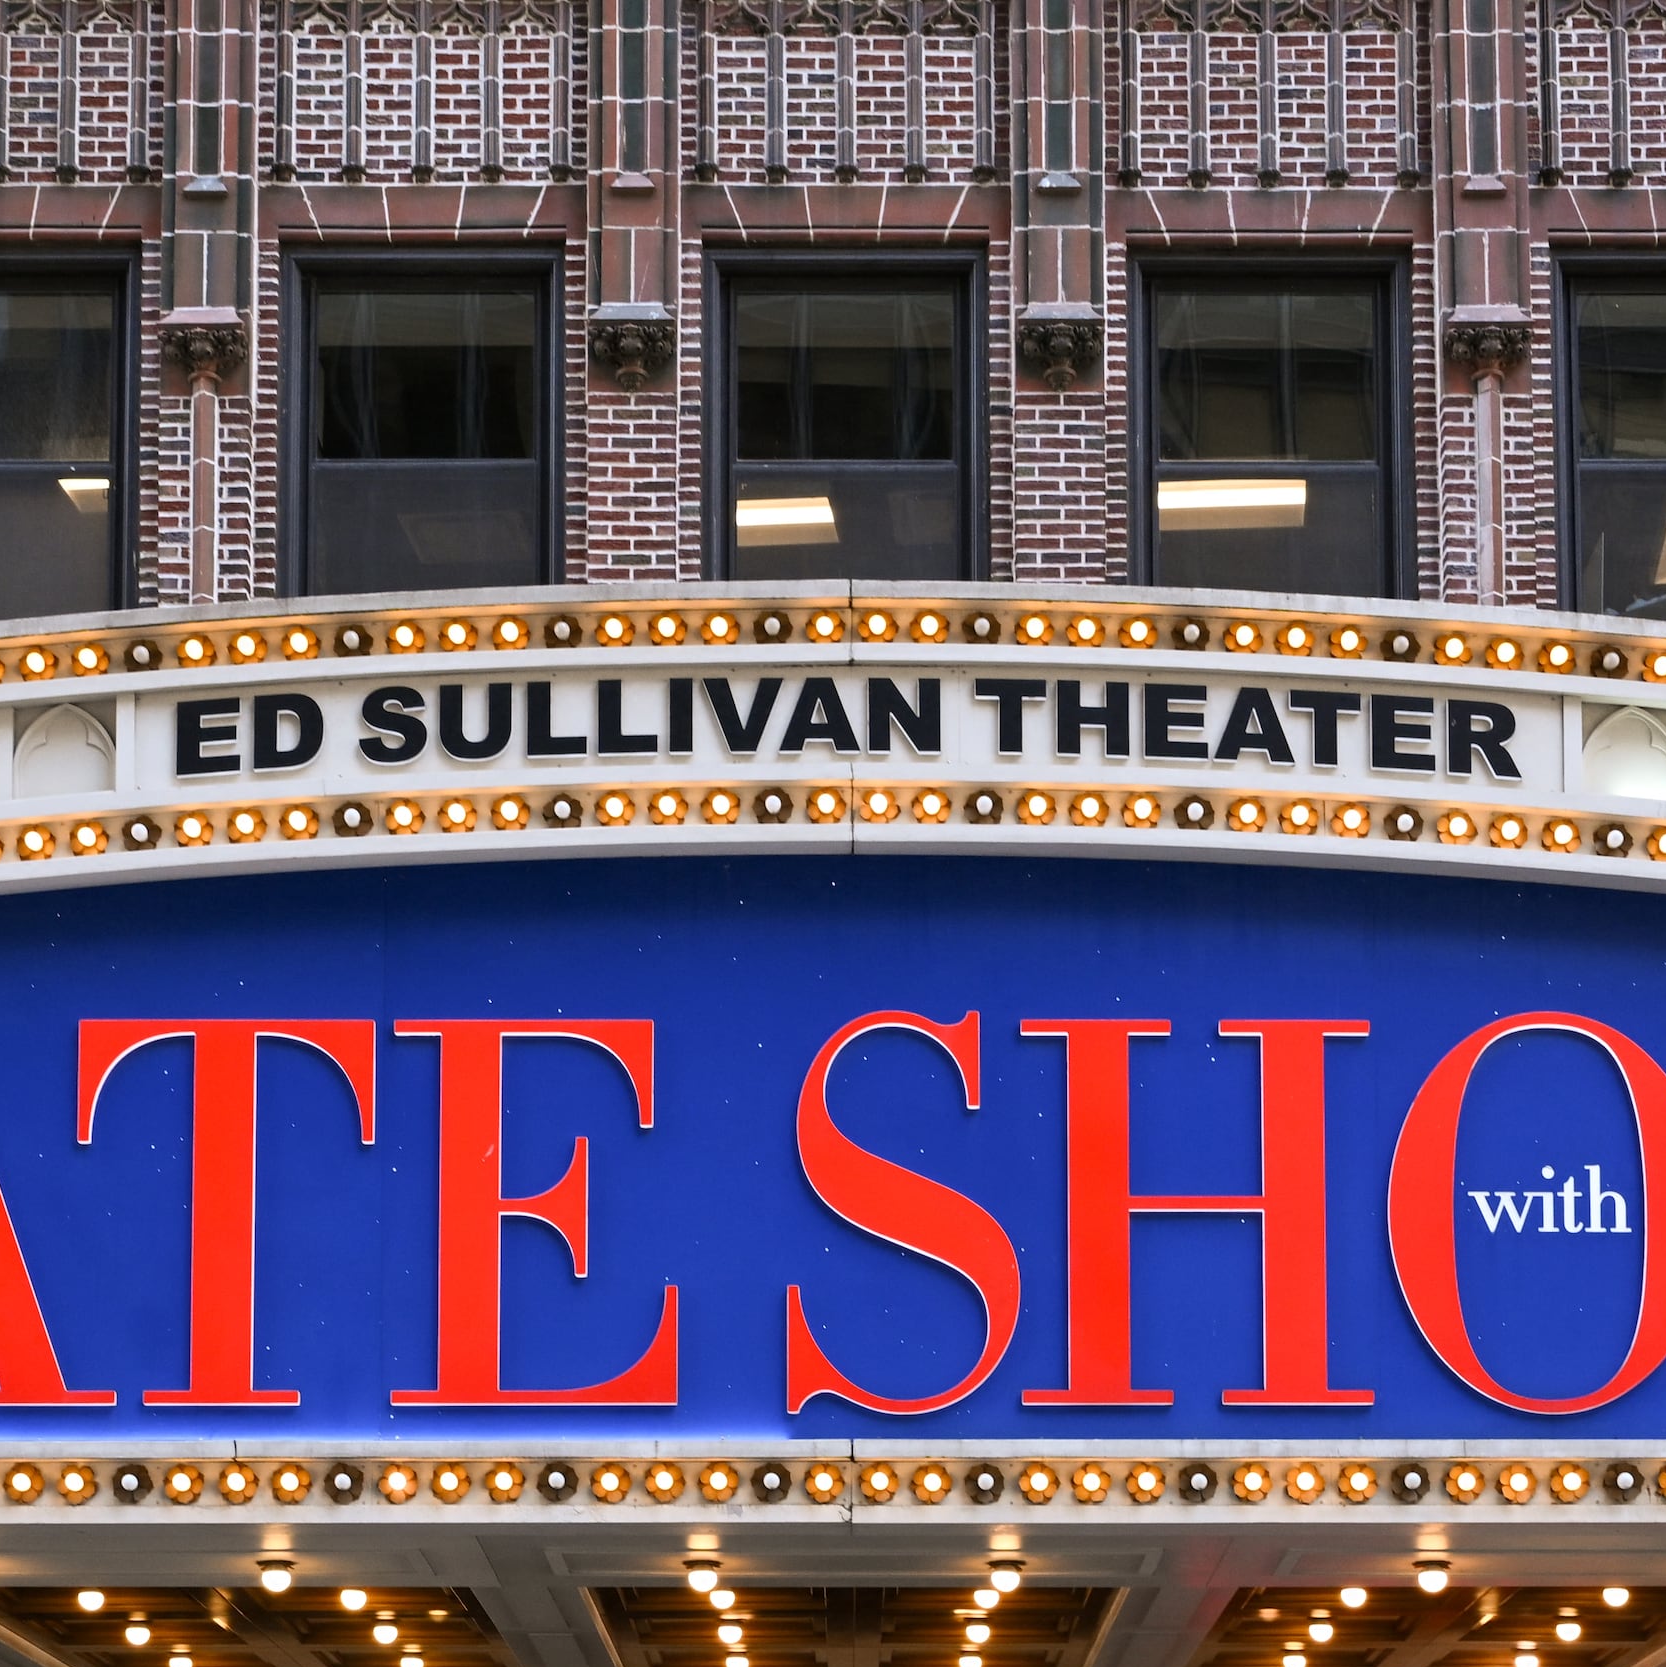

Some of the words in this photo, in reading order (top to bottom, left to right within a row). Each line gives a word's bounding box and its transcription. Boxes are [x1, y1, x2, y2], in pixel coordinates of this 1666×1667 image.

[177, 694, 323, 775] ED
[359, 678, 941, 763] SULLIVAN
[976, 679, 1522, 778] THEATER
[1468, 1165, 1632, 1233] with
